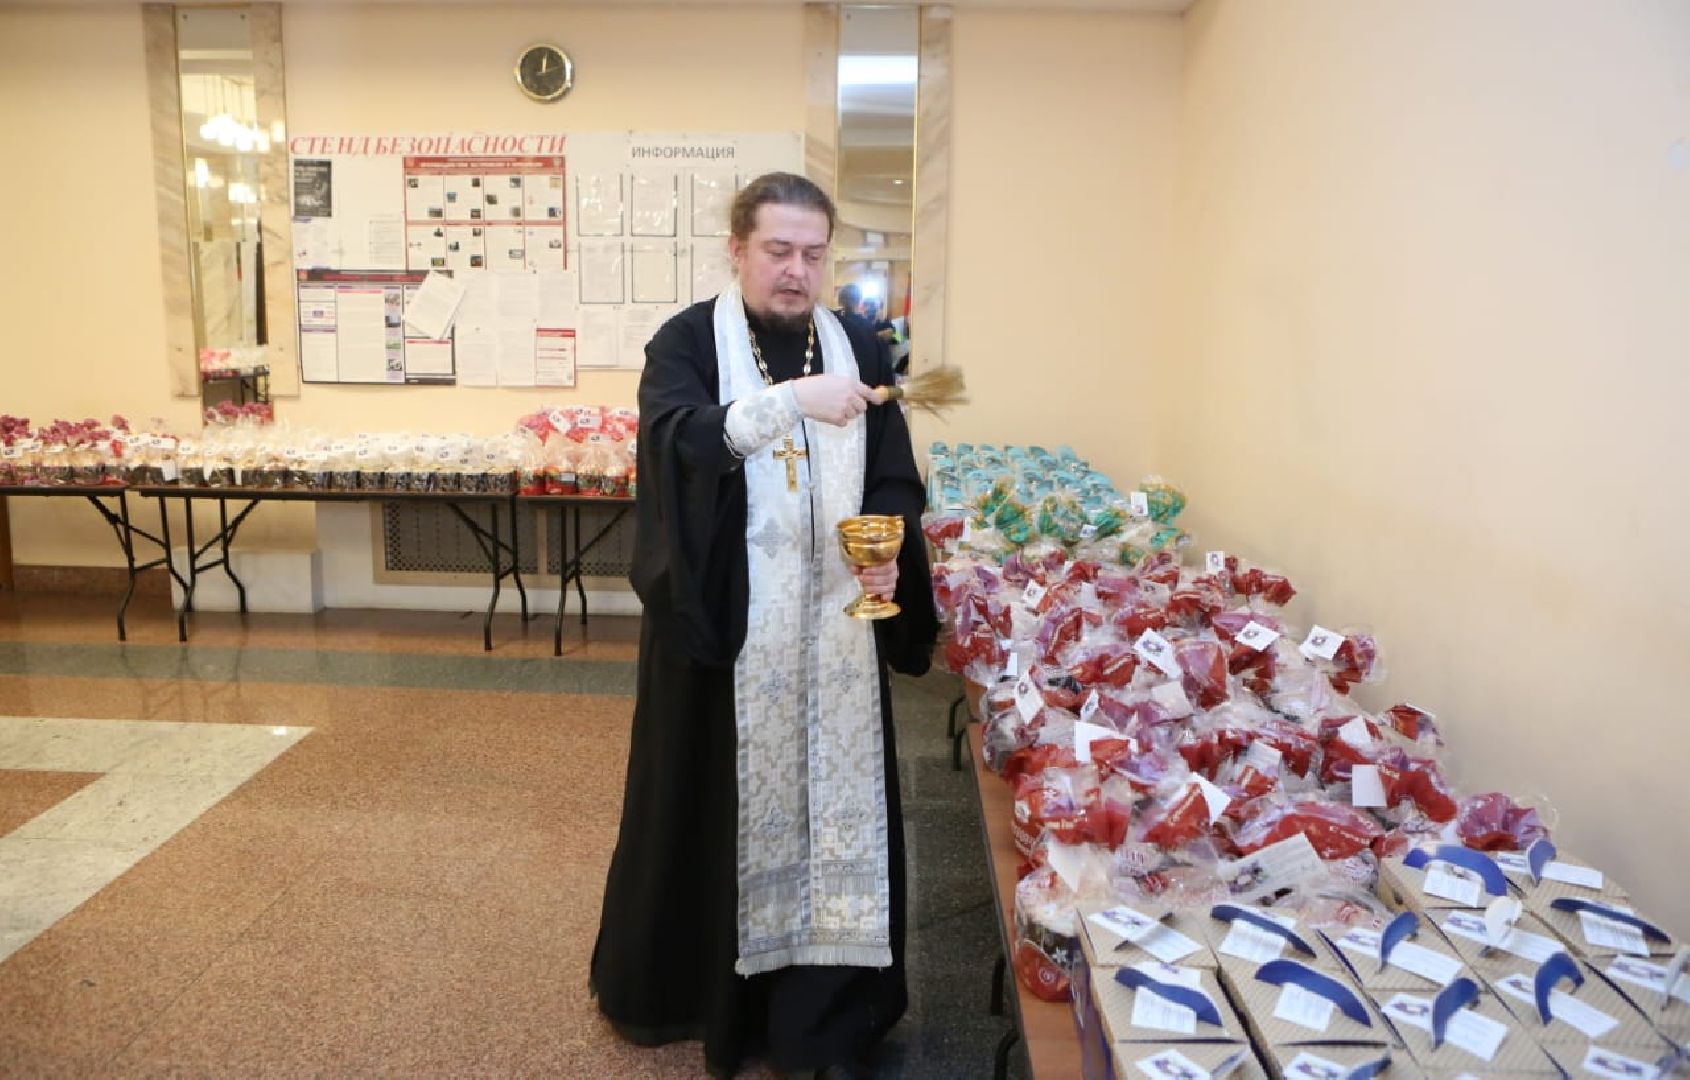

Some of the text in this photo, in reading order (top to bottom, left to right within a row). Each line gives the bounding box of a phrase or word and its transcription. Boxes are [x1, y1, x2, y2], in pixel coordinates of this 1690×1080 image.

[290, 134, 567, 157] СТЕНД БЕЗОПАСНОСТИ
[631, 146, 735, 160] ИНФОРМАЦИЯ
